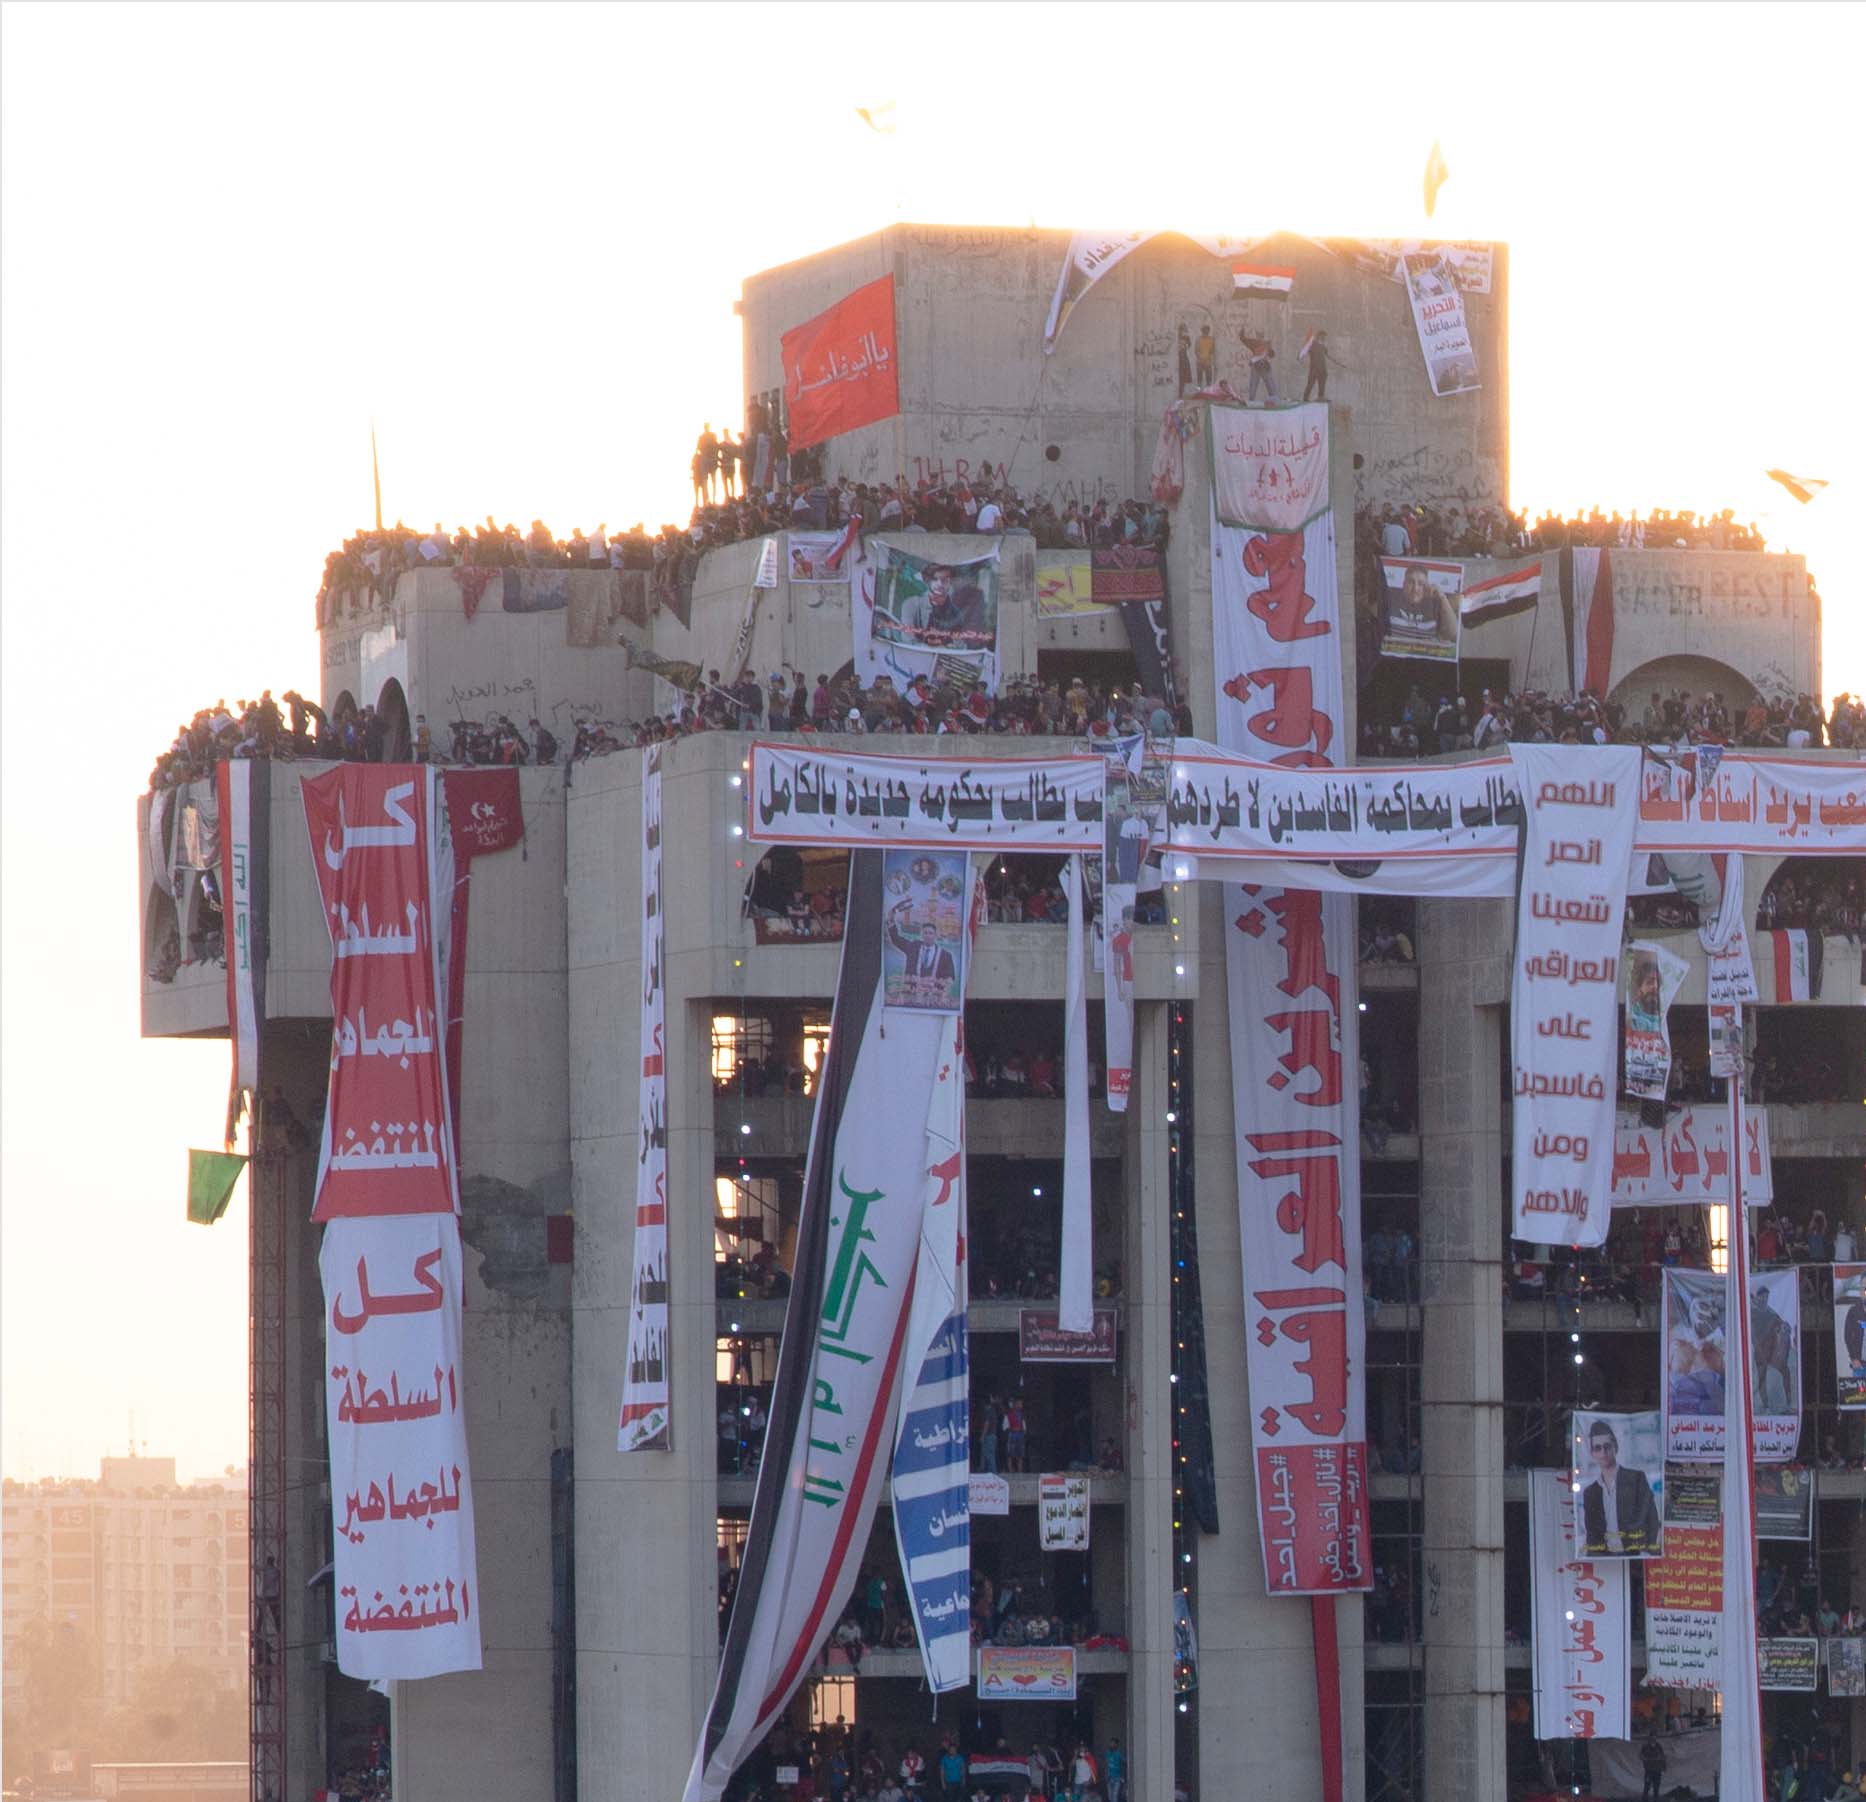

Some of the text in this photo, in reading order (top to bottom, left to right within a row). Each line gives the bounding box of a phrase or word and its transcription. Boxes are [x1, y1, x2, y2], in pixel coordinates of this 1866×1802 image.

[759, 761, 837, 829] بالكامل
[845, 766, 911, 832] جديدة
[920, 768, 994, 833] بحكومة
[1000, 768, 1067, 836] يطالب
[1166, 775, 1241, 842] طردهم
[1247, 776, 1261, 830] لا
[1268, 780, 1358, 844] الفاسدين
[1366, 779, 1453, 844] بمحاكمة
[1460, 776, 1528, 840] طالب
[1536, 780, 1616, 810] اللهم
[1766, 784, 1812, 838] يريد
[325, 781, 416, 872] كل
[1545, 837, 1602, 867] انصر
[1531, 892, 1611, 926] شعبنا
[1525, 953, 1616, 985] العراقي
[1537, 1012, 1593, 1041] على
[330, 1118, 447, 1172] المنتفض
[1533, 1127, 1590, 1162] ومن
[1520, 1188, 1590, 1222] والاهم
[332, 1247, 444, 1336] كل
[1244, 1130, 1349, 1437] العراقية
[331, 1363, 457, 1424] السلطة
[336, 1463, 462, 1544] للجماهير
[340, 1576, 471, 1634] المنتفضة
[984, 1674, 1002, 1687] A
[1050, 1673, 1068, 1688] S
